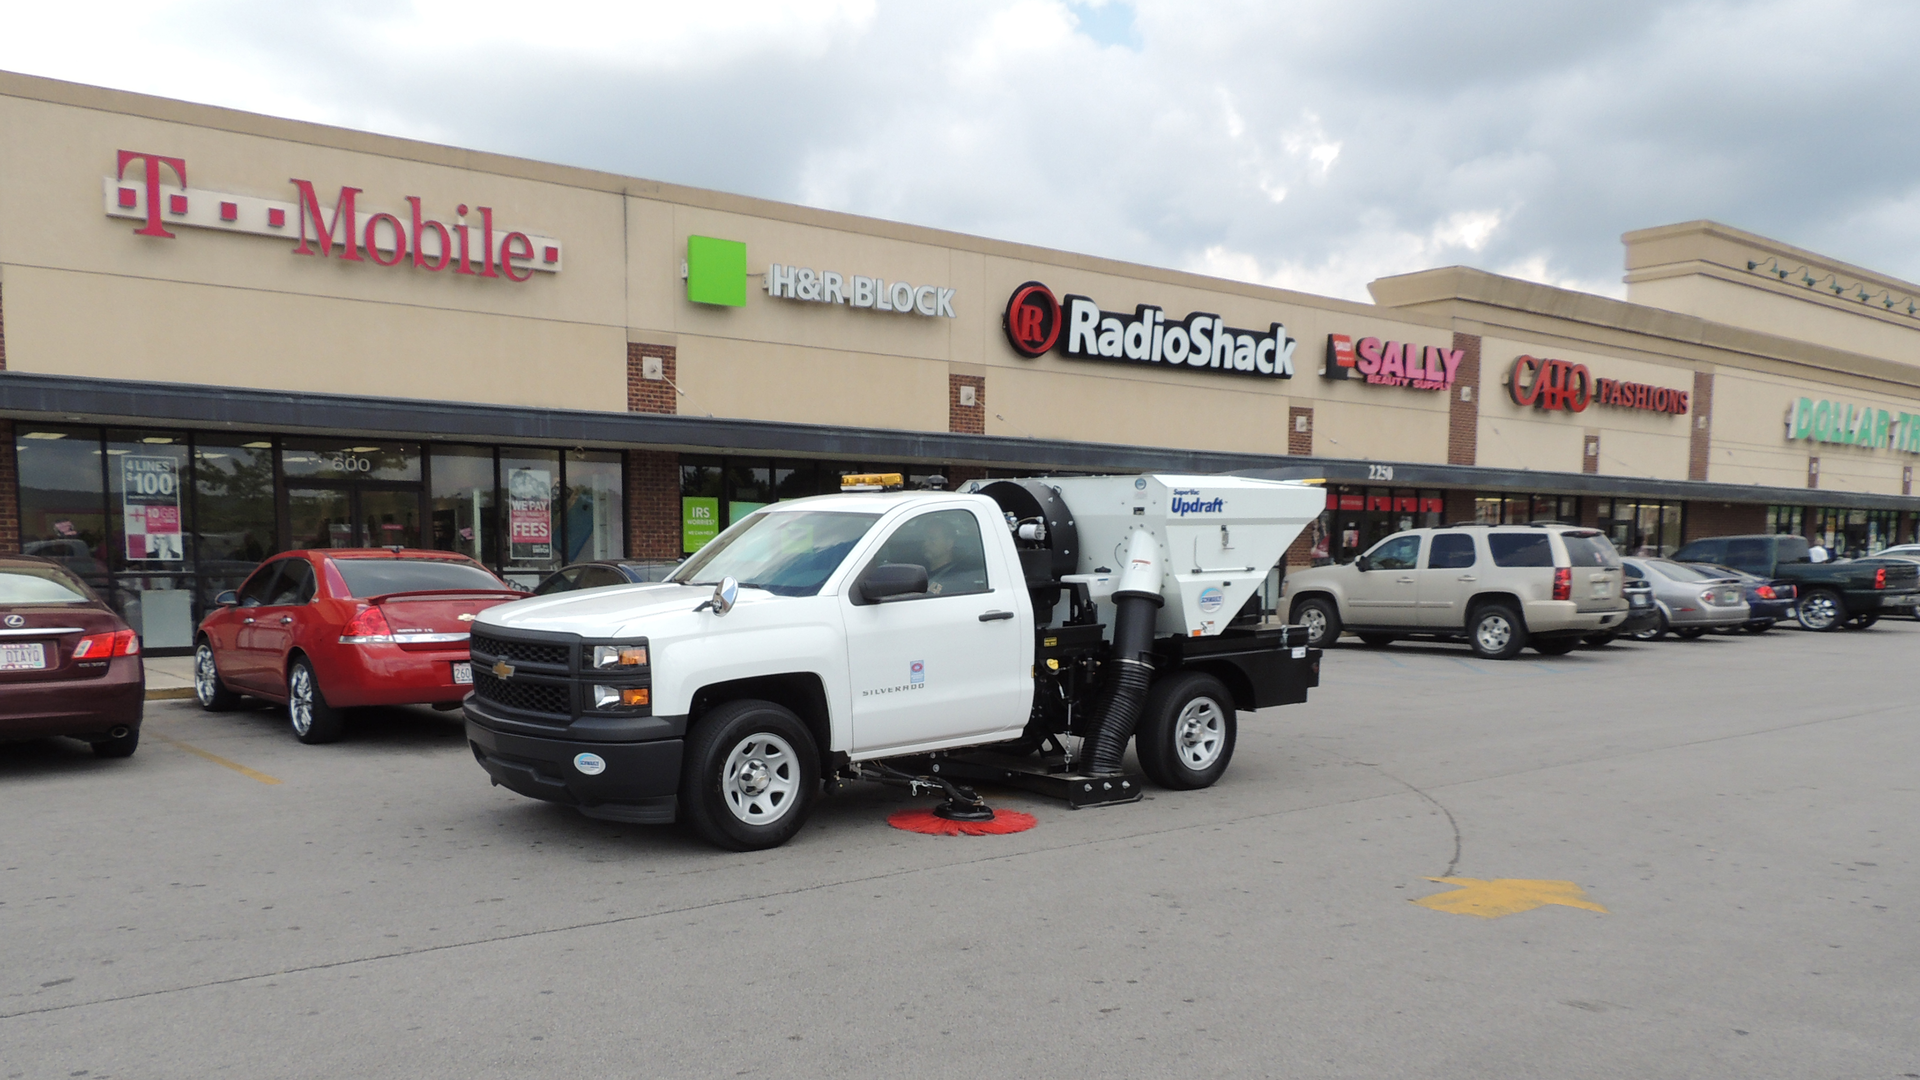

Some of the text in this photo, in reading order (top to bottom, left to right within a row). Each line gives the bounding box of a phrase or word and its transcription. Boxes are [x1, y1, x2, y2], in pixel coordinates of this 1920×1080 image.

[289, 177, 536, 283] Mobile
[769, 263, 957, 318] H&R BLOCK
[1020, 304, 1044, 342] R
[1068, 298, 1297, 376] RadioShack
[1356, 336, 1465, 383] SALLY
[1366, 374, 1452, 391] BEAUTY SUPPLY
[1509, 354, 1690, 414] CATO FASHIONS
[1790, 397, 1890, 449] DOLLAR
[126, 460, 171, 472] 4 LINES
[332, 458, 370, 472] 600
[1368, 465, 1394, 481] 2250
[147, 508, 176, 518] 10 GB
[512, 500, 548, 511] WE PAY
[692, 507, 710, 518] IRS
[1171, 497, 1223, 517] Updraft
[513, 522, 548, 536] FEES
[862, 683, 925, 697] SILVERADO
